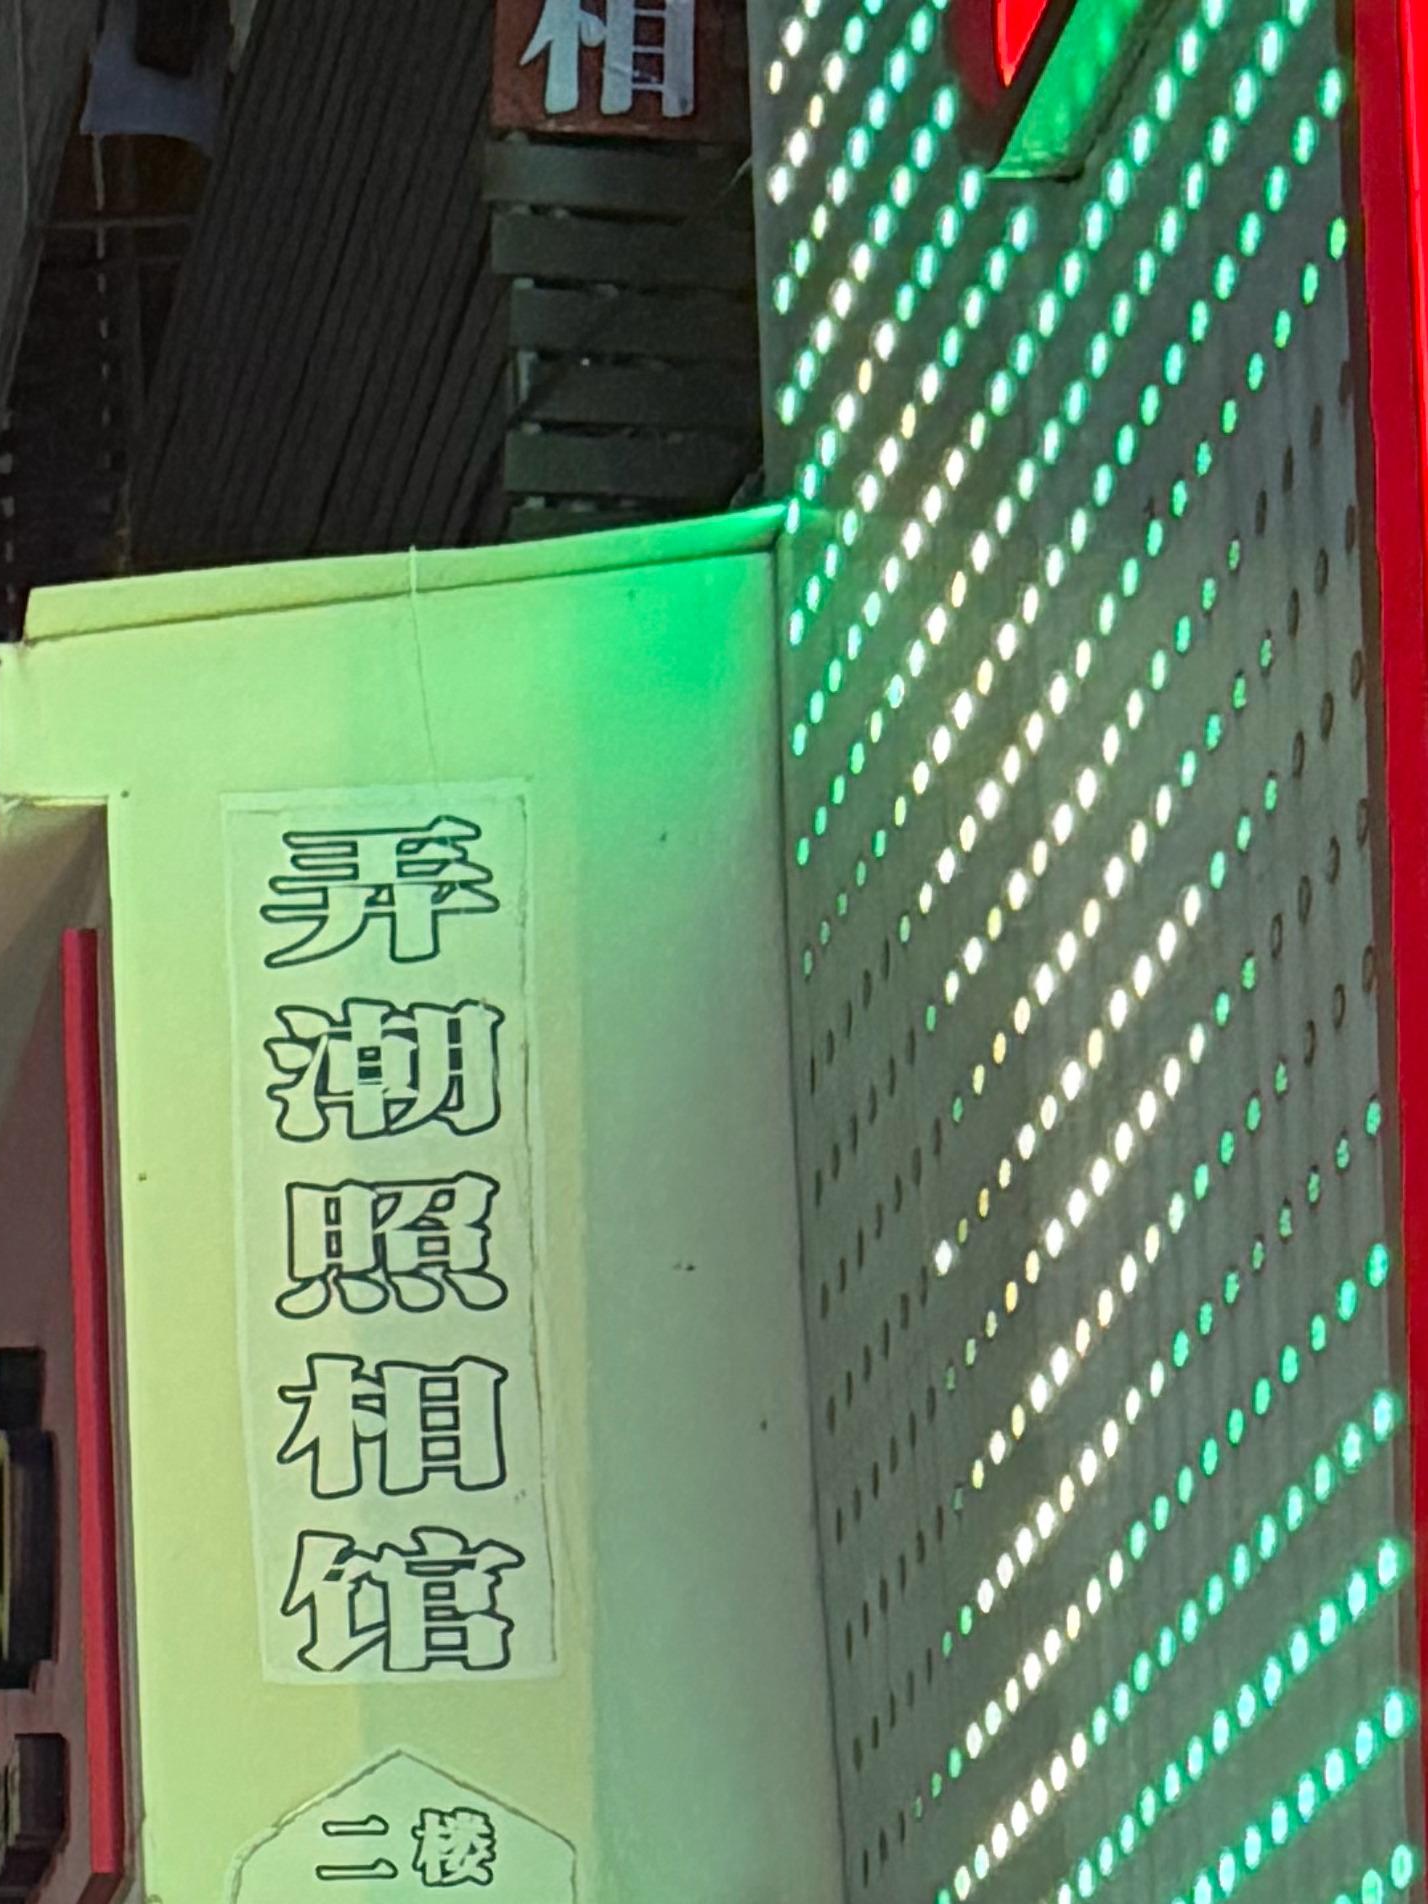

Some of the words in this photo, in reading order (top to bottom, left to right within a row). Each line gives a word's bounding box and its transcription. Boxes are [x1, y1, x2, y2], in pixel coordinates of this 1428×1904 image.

[519, 0, 695, 117] 相
[260, 812, 526, 1674] 弄潮照相馆
[315, 1804, 499, 1889] 二楼
